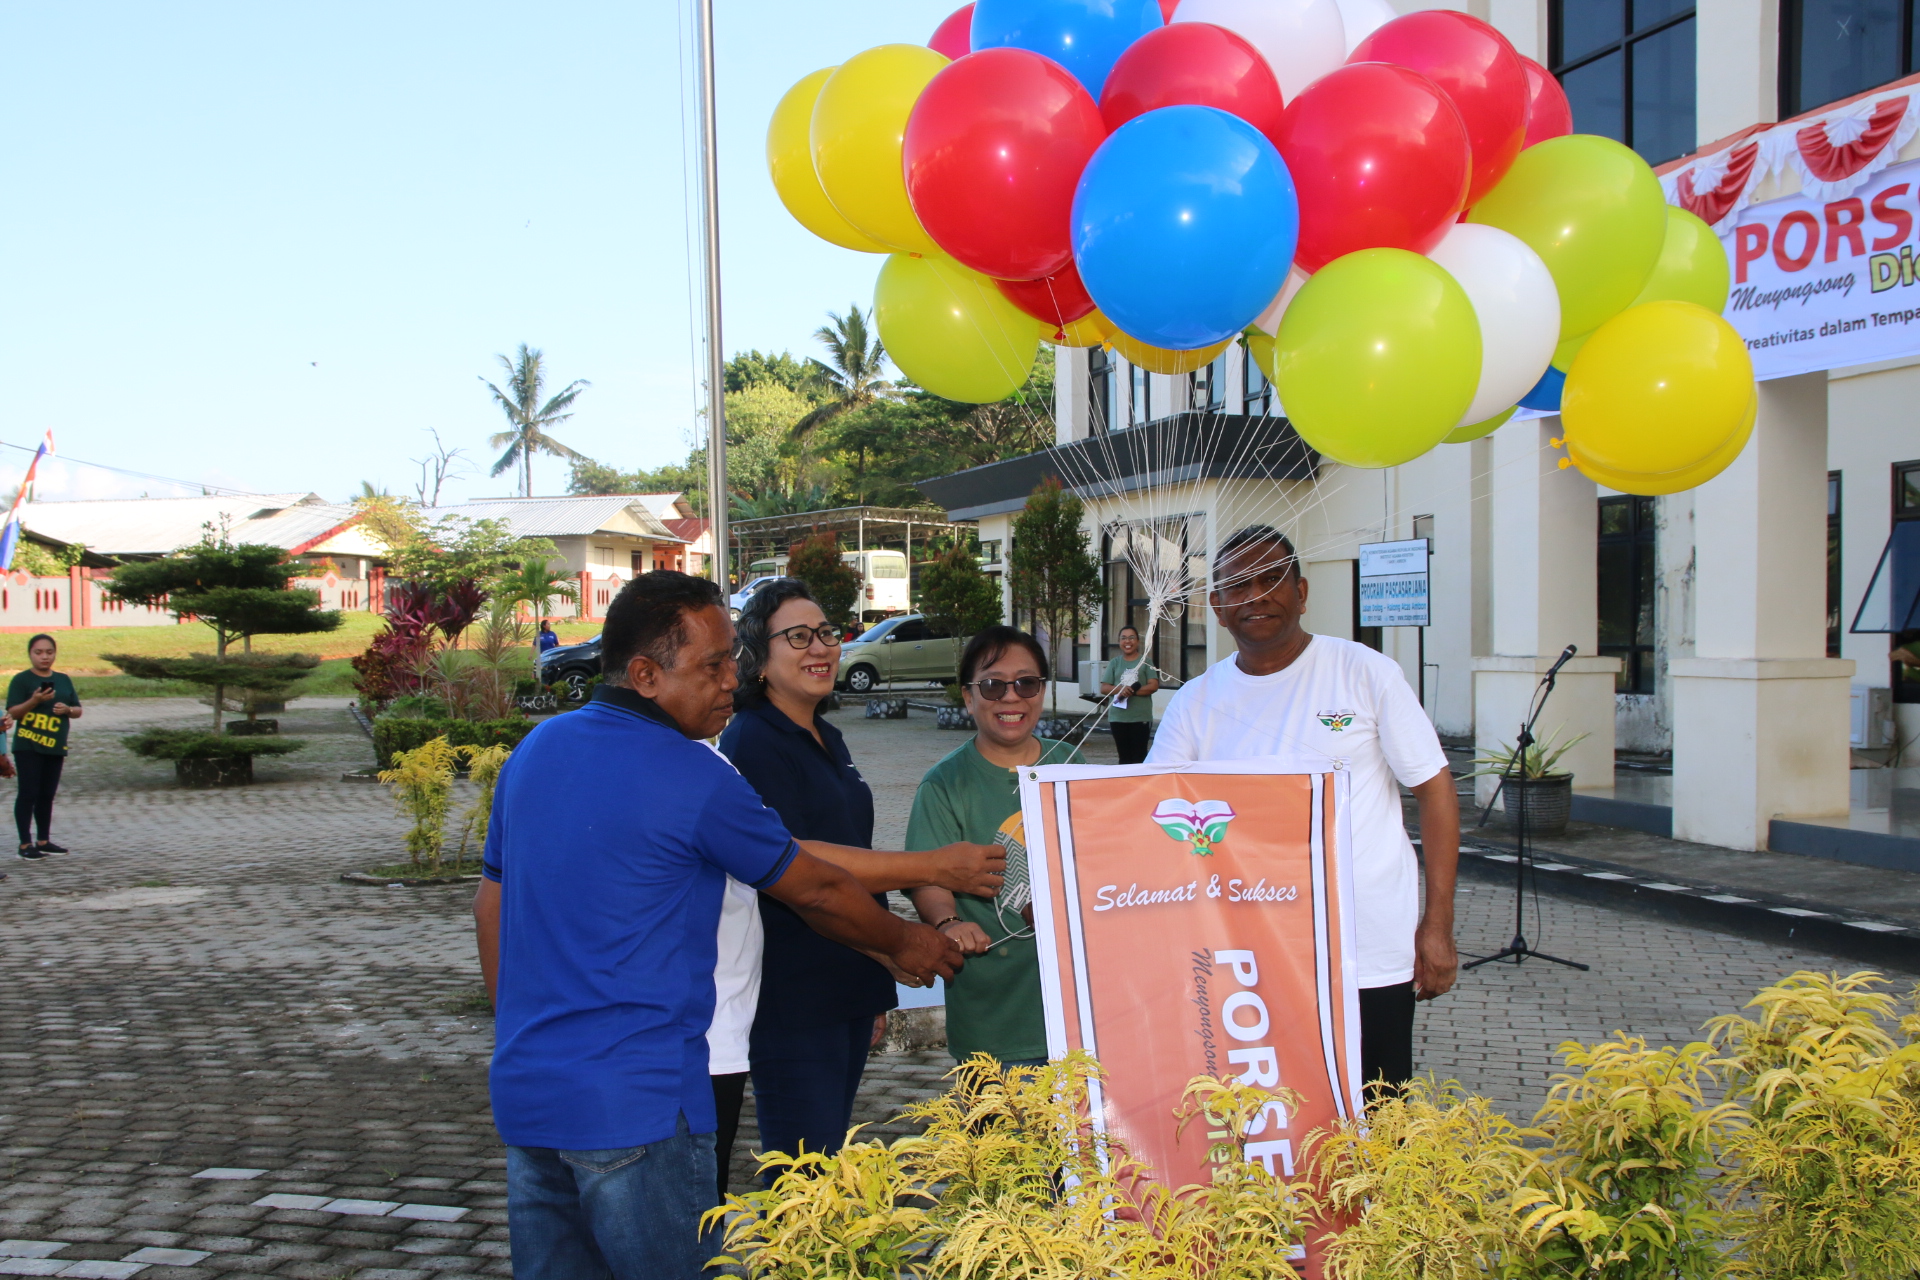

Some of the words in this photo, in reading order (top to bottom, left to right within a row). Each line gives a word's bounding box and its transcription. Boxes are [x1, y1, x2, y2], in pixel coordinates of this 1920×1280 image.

[1735, 181, 1920, 284] PORS
[1731, 272, 1857, 312] Menyongsong
[1743, 329, 1815, 350] reativitas
[1819, 317, 1867, 337] dalam
[1361, 582, 1384, 600] PROGRAM
[1385, 579, 1426, 599] PASCASARJANA
[17, 727, 57, 748] SQUAD
[20, 711, 62, 733] PRC
[1093, 880, 1198, 912] Selamat
[1205, 873, 1222, 899] &
[1227, 877, 1299, 903] Sukses
